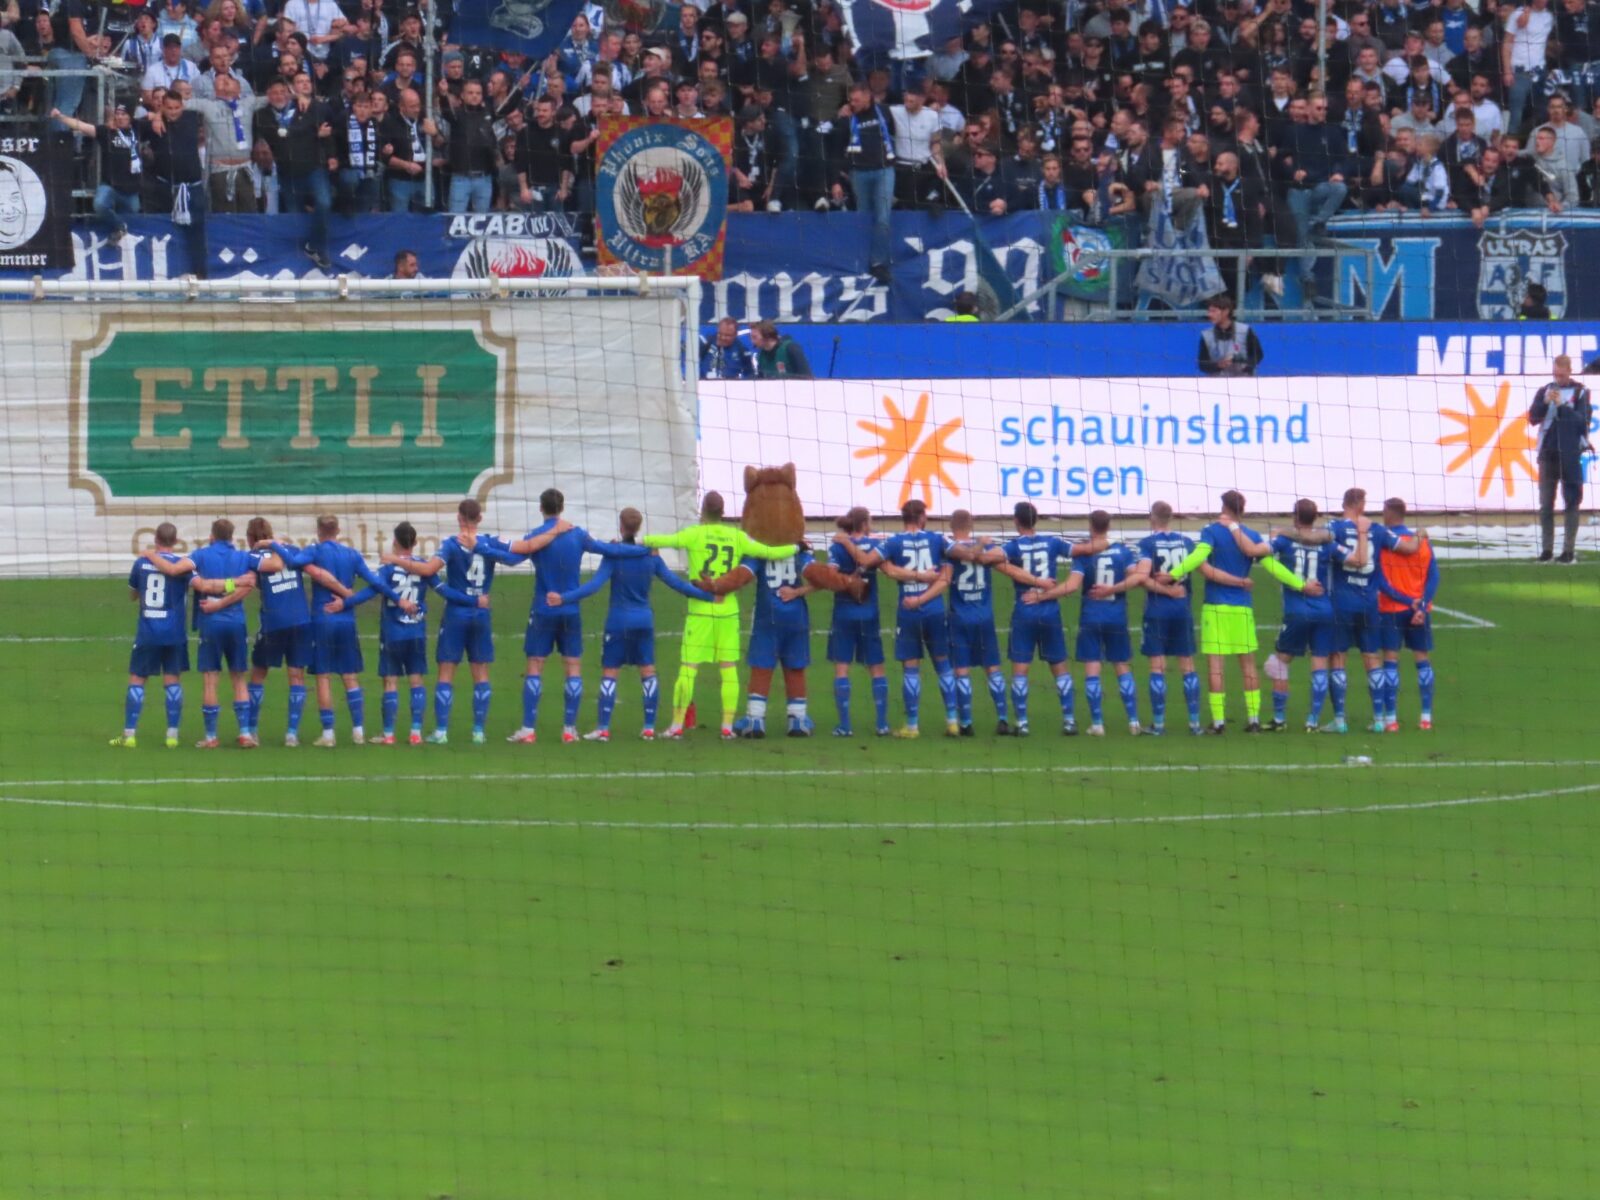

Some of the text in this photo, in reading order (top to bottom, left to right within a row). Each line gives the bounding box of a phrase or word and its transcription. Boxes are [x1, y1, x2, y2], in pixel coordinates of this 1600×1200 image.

[448, 213, 526, 237] ACAB
[1486, 238, 1558, 258] ULTRAS
[1416, 335, 1598, 375] MEINE
[131, 365, 447, 450] ETTLI
[1000, 403, 1310, 447] schauinsland
[1000, 454, 1144, 497] reisen
[466, 554, 486, 587] 4
[702, 543, 734, 577] 23
[765, 556, 797, 589] 94
[957, 561, 986, 591] 21
[1020, 551, 1049, 580] 13
[1293, 549, 1320, 582] 11
[144, 573, 166, 608] 8
